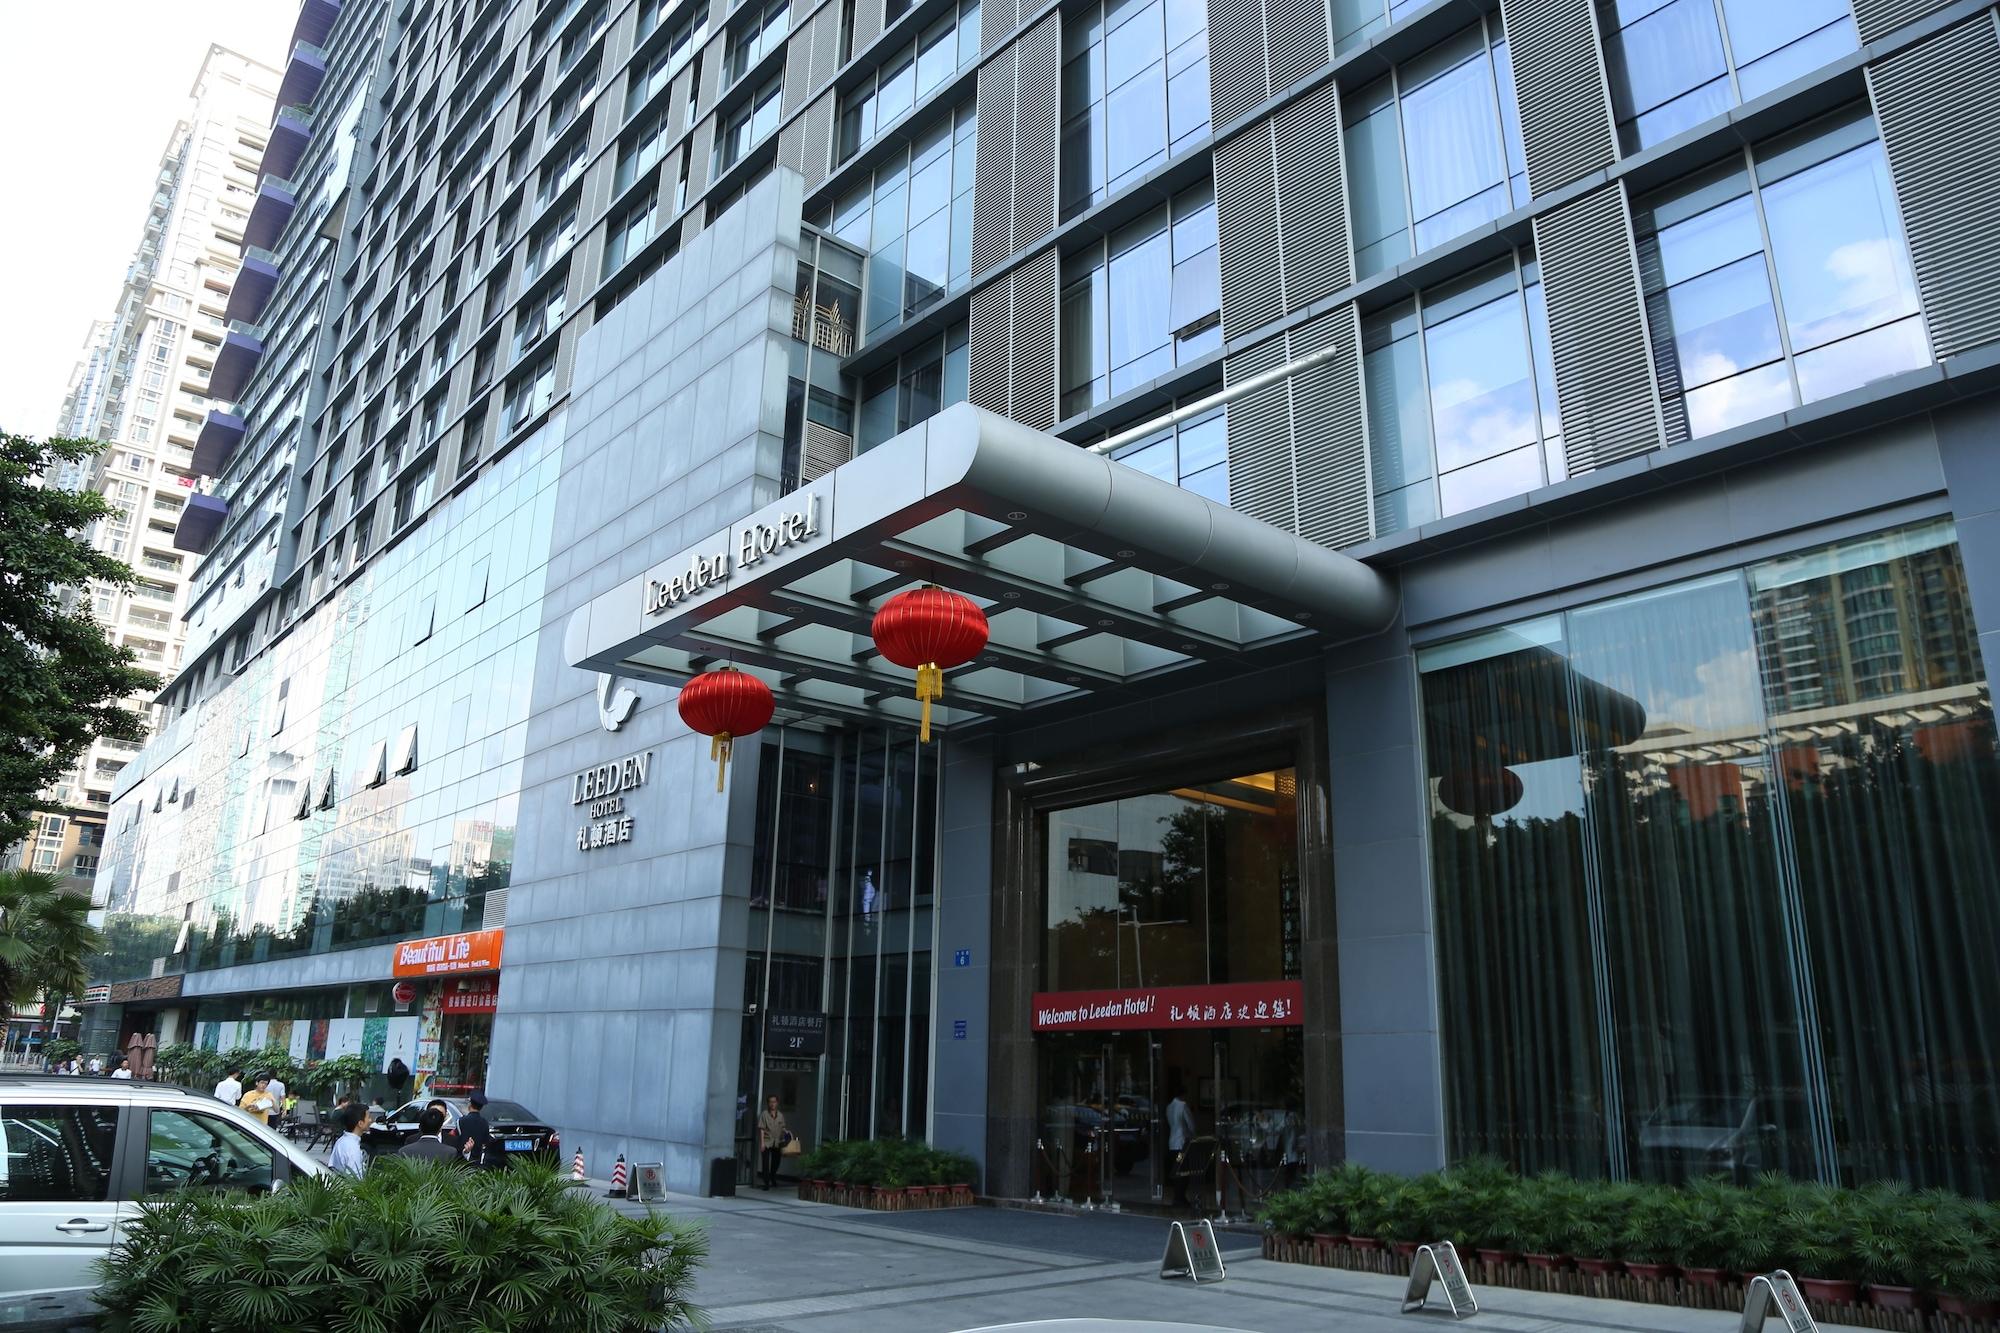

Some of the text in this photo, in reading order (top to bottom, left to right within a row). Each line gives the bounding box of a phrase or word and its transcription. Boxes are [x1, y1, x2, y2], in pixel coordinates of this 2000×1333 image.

[644, 492, 819, 616] Leeden Hotel
[571, 751, 653, 805] LEEDEN
[589, 797, 624, 820] HOTEL
[576, 815, 636, 850] 礼顿酒店
[400, 937, 470, 965] Beautiful Life
[1038, 1007, 1077, 1026] Welcome
[1078, 1006, 1088, 1022] to
[1089, 1000, 1121, 1018] Leeden
[789, 1037, 804, 1048] 2F
